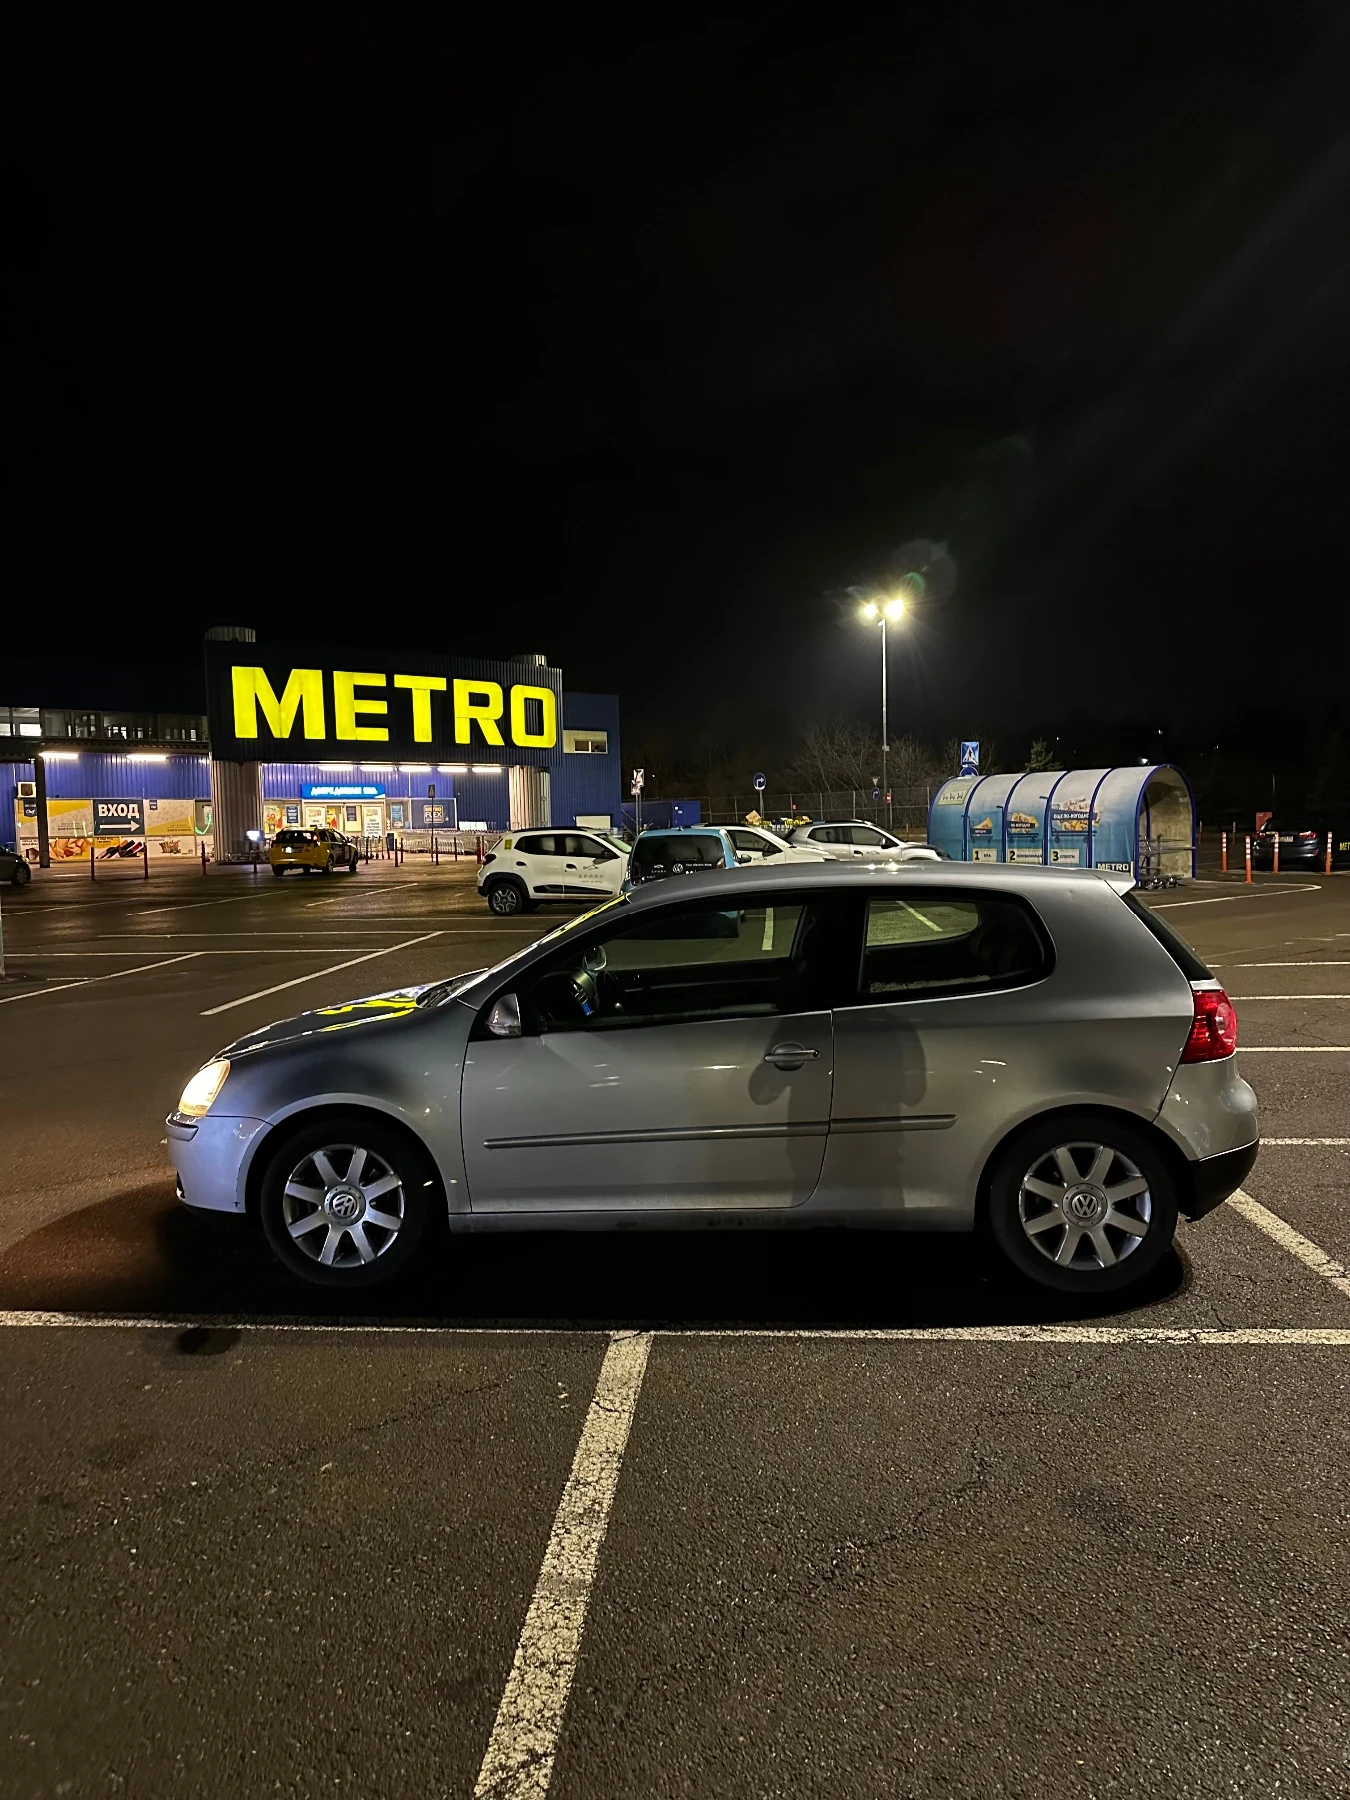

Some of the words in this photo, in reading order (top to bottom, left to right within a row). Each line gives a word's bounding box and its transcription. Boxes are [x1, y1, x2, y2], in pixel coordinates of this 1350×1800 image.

[231, 665, 556, 748] METRO
[98, 804, 140, 819] ВХОД
[975, 850, 980, 861] 1
[1010, 850, 1016, 861] 2
[1053, 851, 1060, 862] 3
[1098, 863, 1129, 871] METRO
